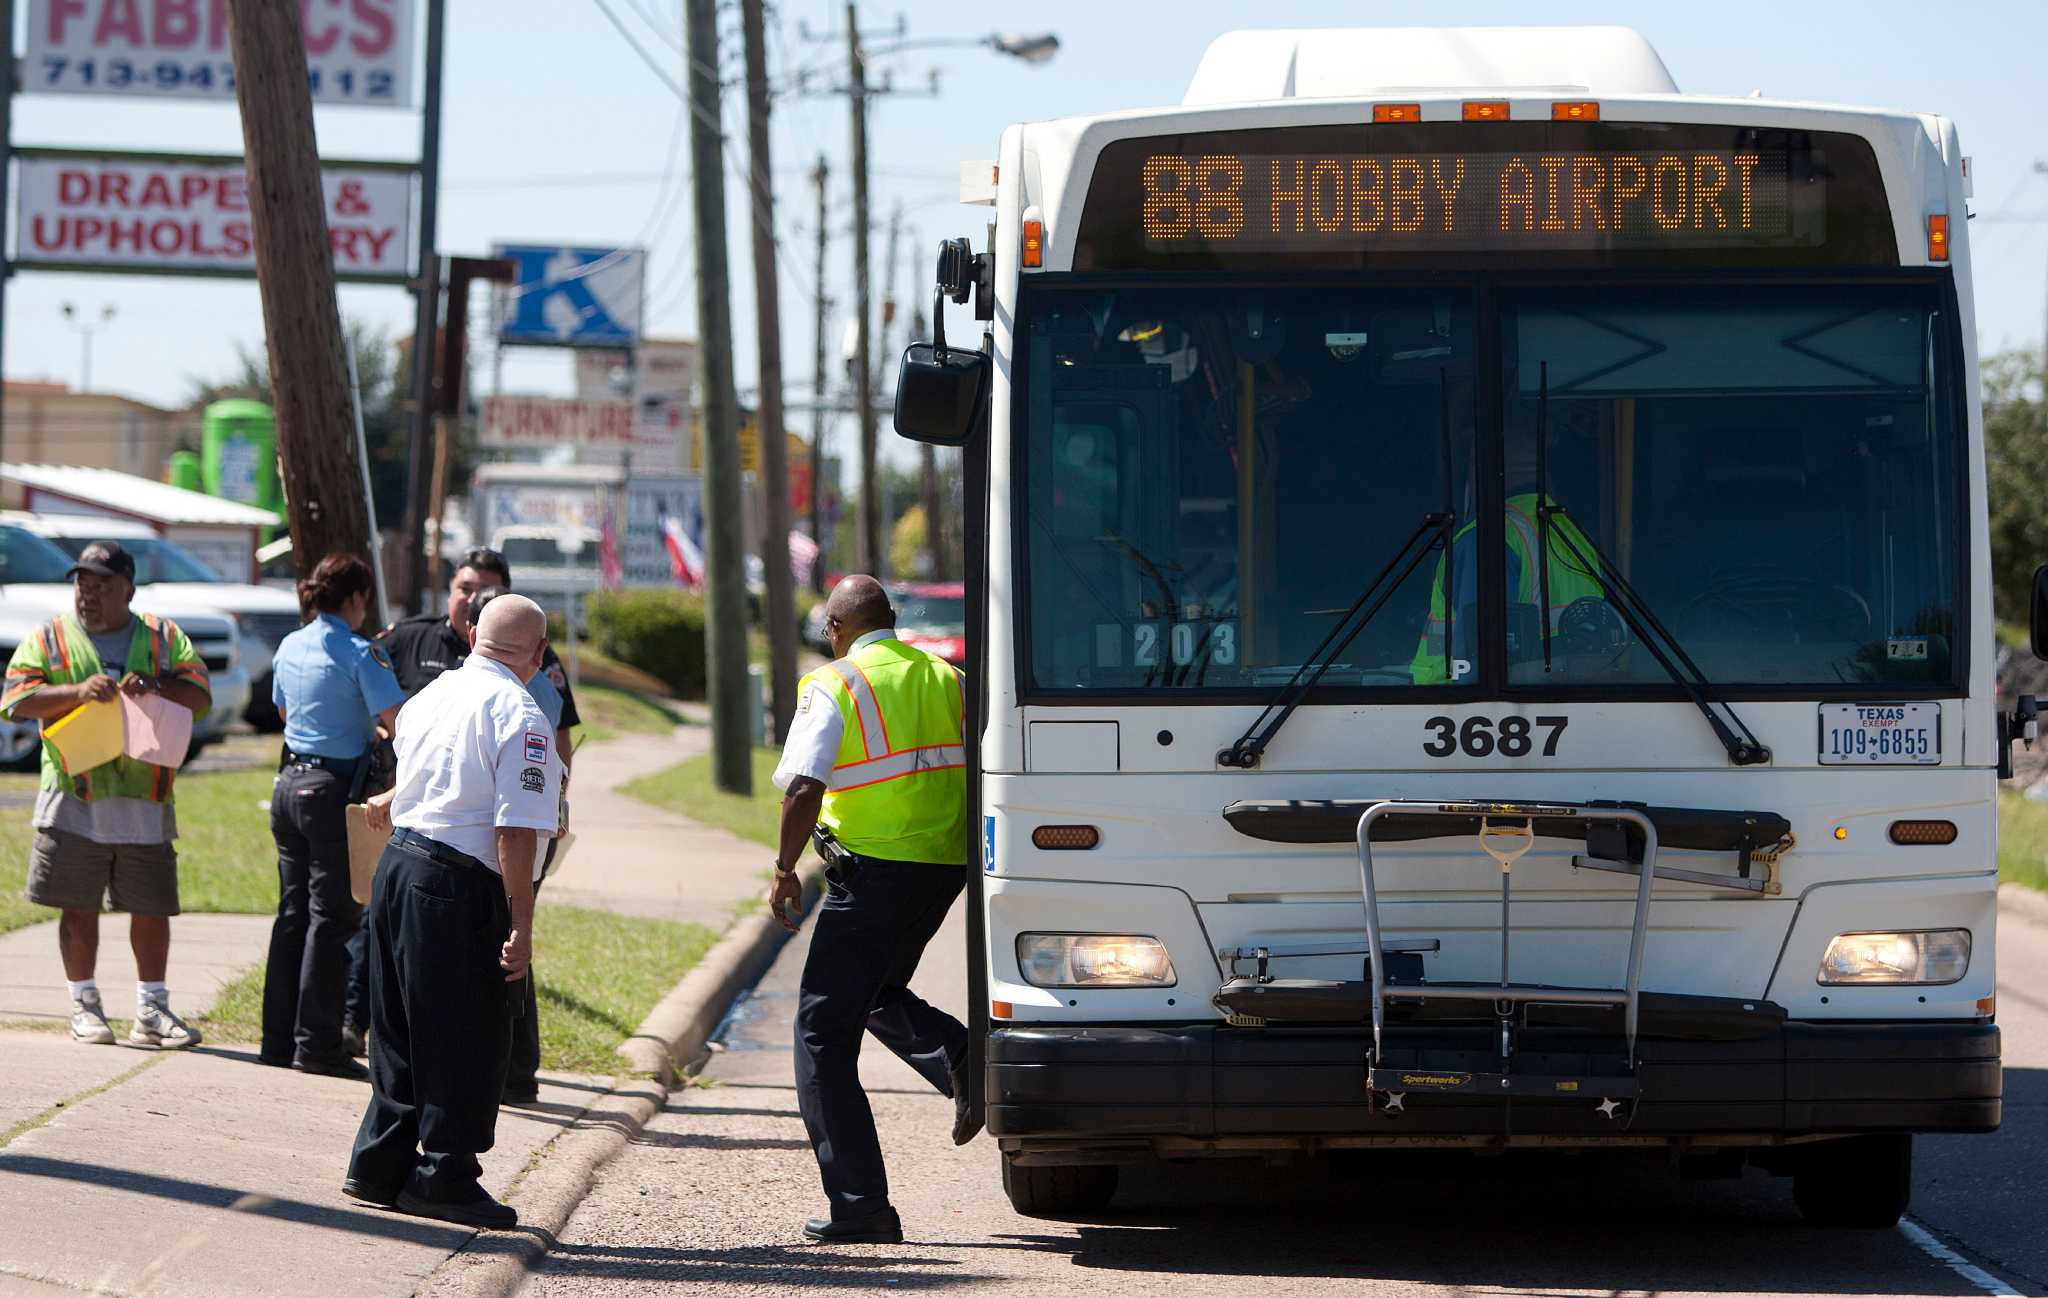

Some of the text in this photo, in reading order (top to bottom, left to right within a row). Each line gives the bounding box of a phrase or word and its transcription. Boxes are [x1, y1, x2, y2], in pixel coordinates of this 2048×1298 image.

[334, 180, 372, 217] &
[1143, 154, 1761, 240] 88 HOBBY AIRPORT
[32, 215, 395, 264] UPHOLSRY
[1452, 660, 1471, 681] P
[1857, 708, 1905, 720] TEXAS
[1862, 720, 1899, 728] EXEMPT
[1422, 715, 1569, 758] 3687
[1402, 1074, 1461, 1087] Sportworks
